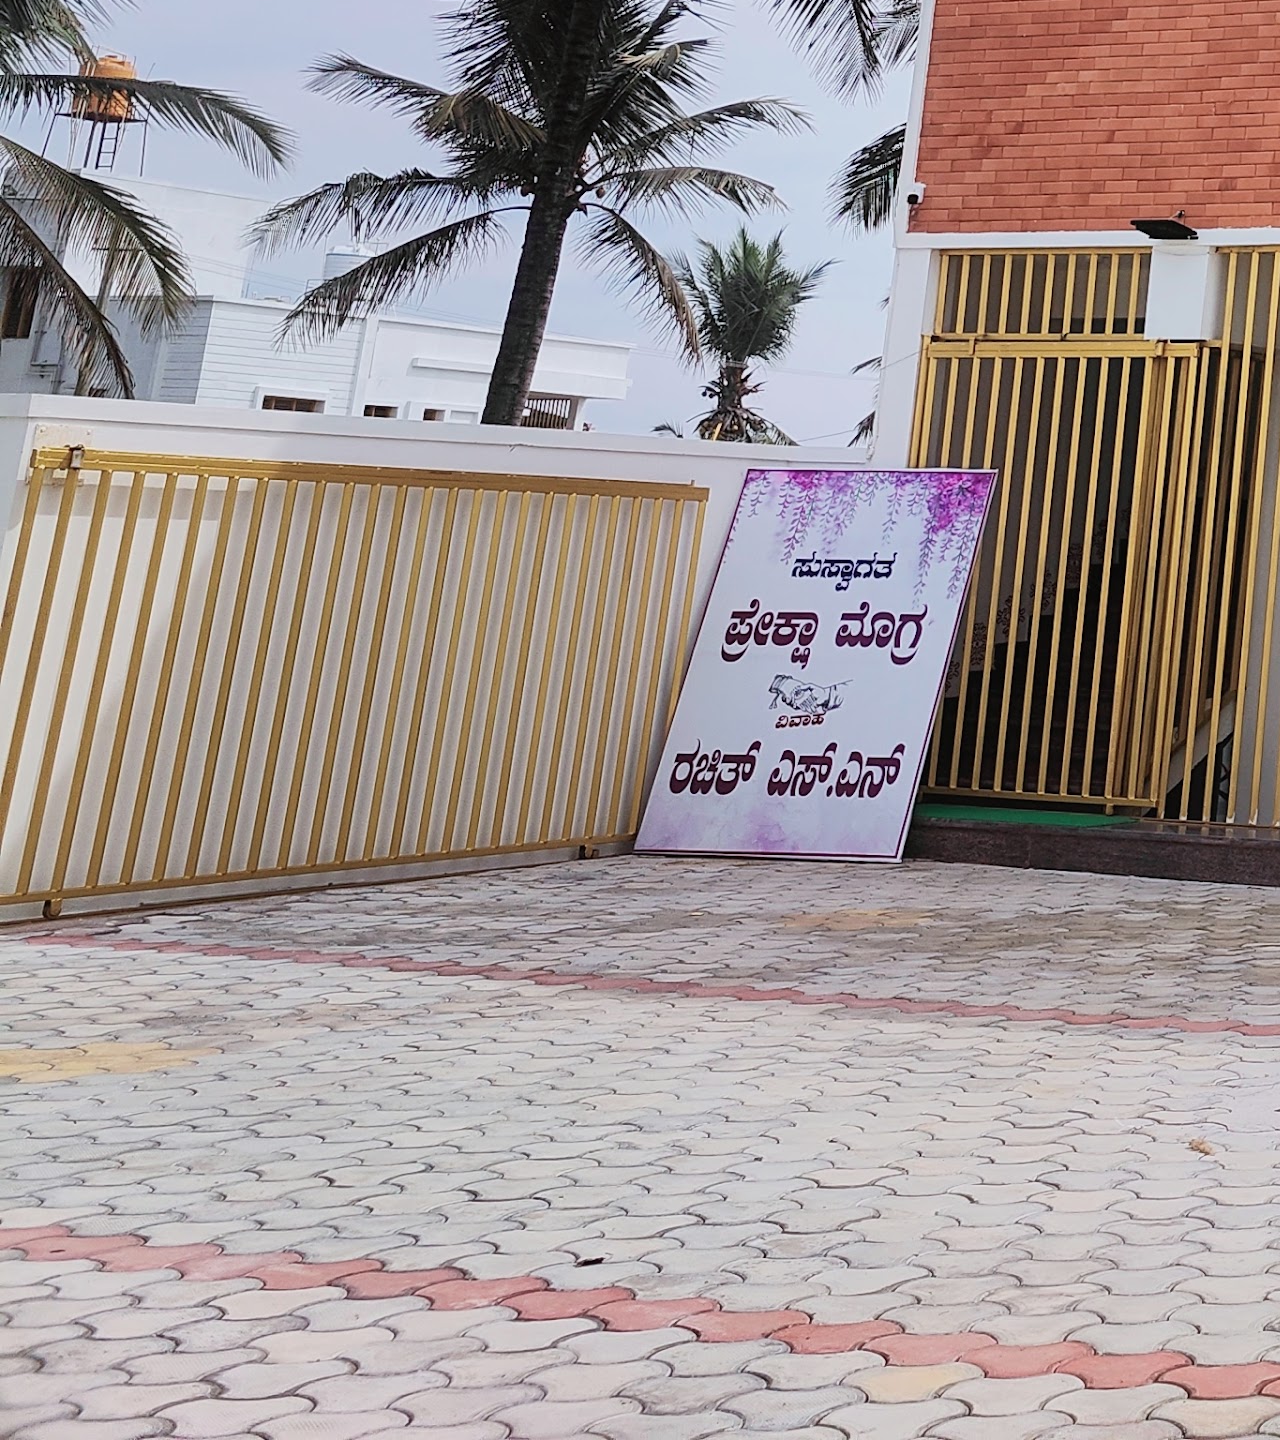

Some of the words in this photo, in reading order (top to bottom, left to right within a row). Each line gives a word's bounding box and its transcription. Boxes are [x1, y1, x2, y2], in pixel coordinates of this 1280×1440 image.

[791, 551, 898, 591] ಸುಸ್ವಾಗತ
[721, 599, 819, 669] ಪ್ರೇಕ್ಷಾ
[835, 601, 928, 665] ಮೊಗ್ರ
[774, 713, 826, 729] ವಿವಾಹ
[669, 738, 762, 795] ರಚಿತ್
